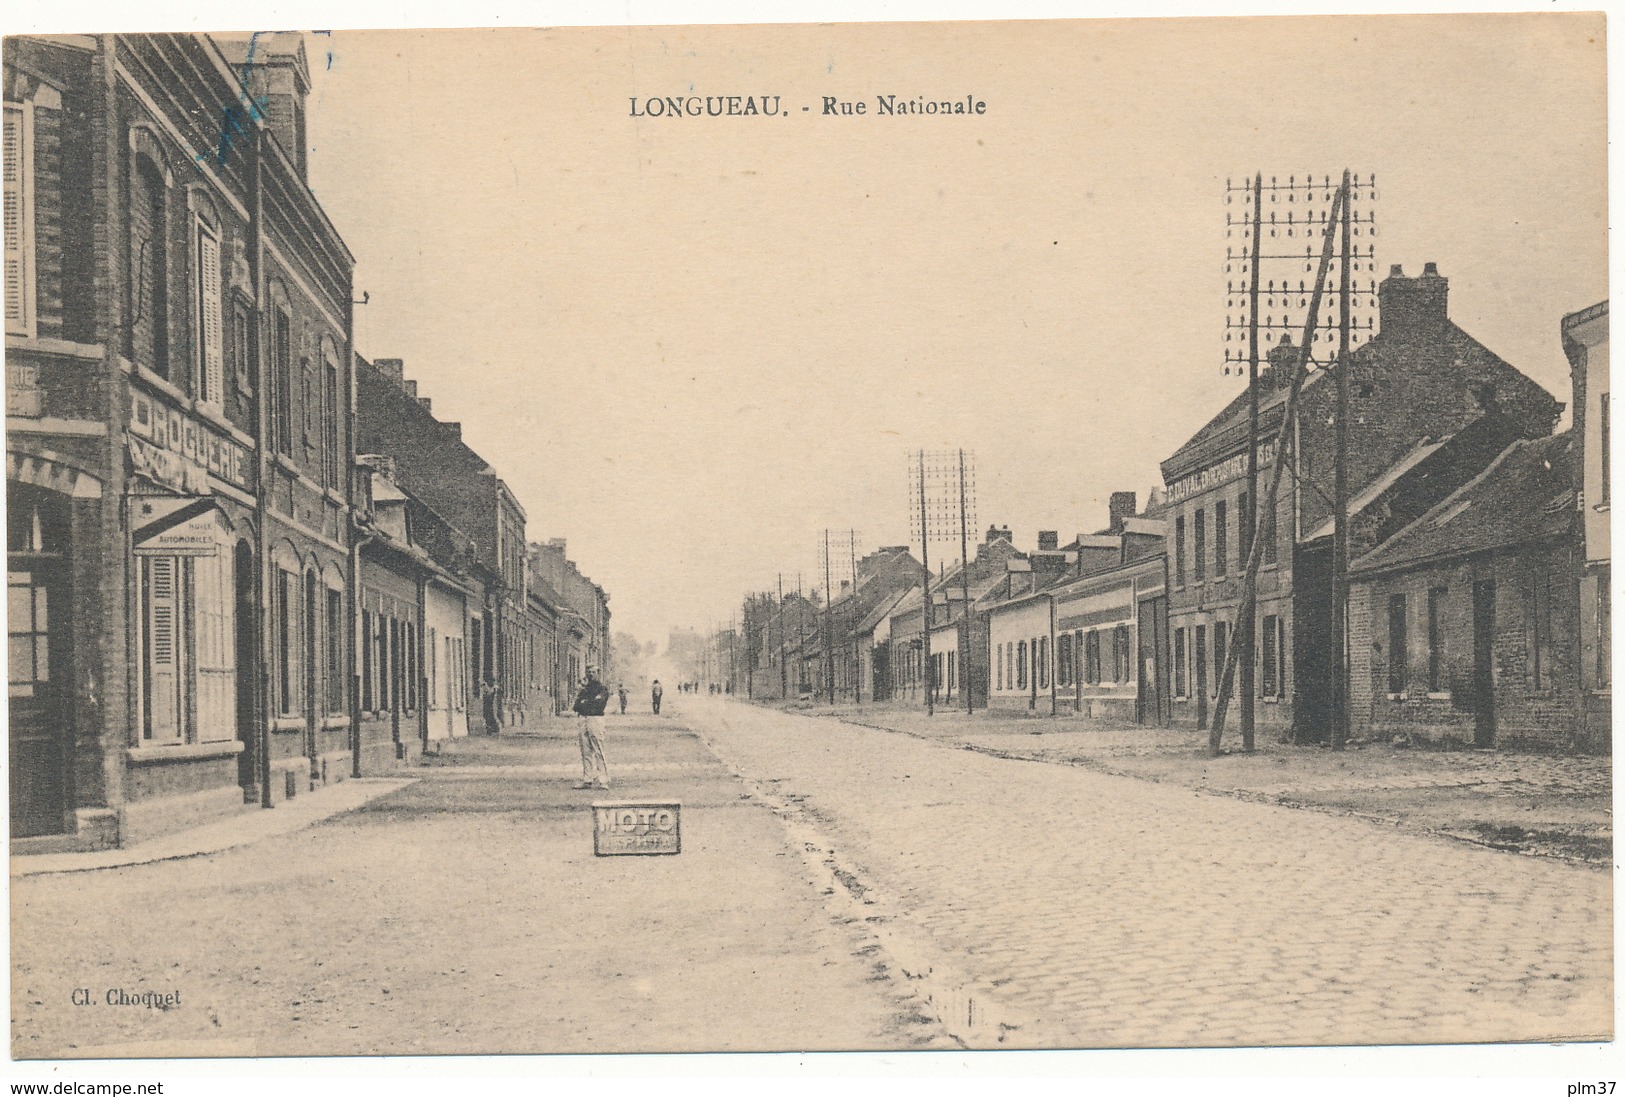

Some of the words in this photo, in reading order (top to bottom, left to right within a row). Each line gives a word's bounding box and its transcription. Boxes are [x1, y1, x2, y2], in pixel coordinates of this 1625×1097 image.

[130, 396, 246, 486] DROGUERIE
[159, 535, 214, 543] AUTOMOBILES
[597, 809, 675, 832] MOTO
